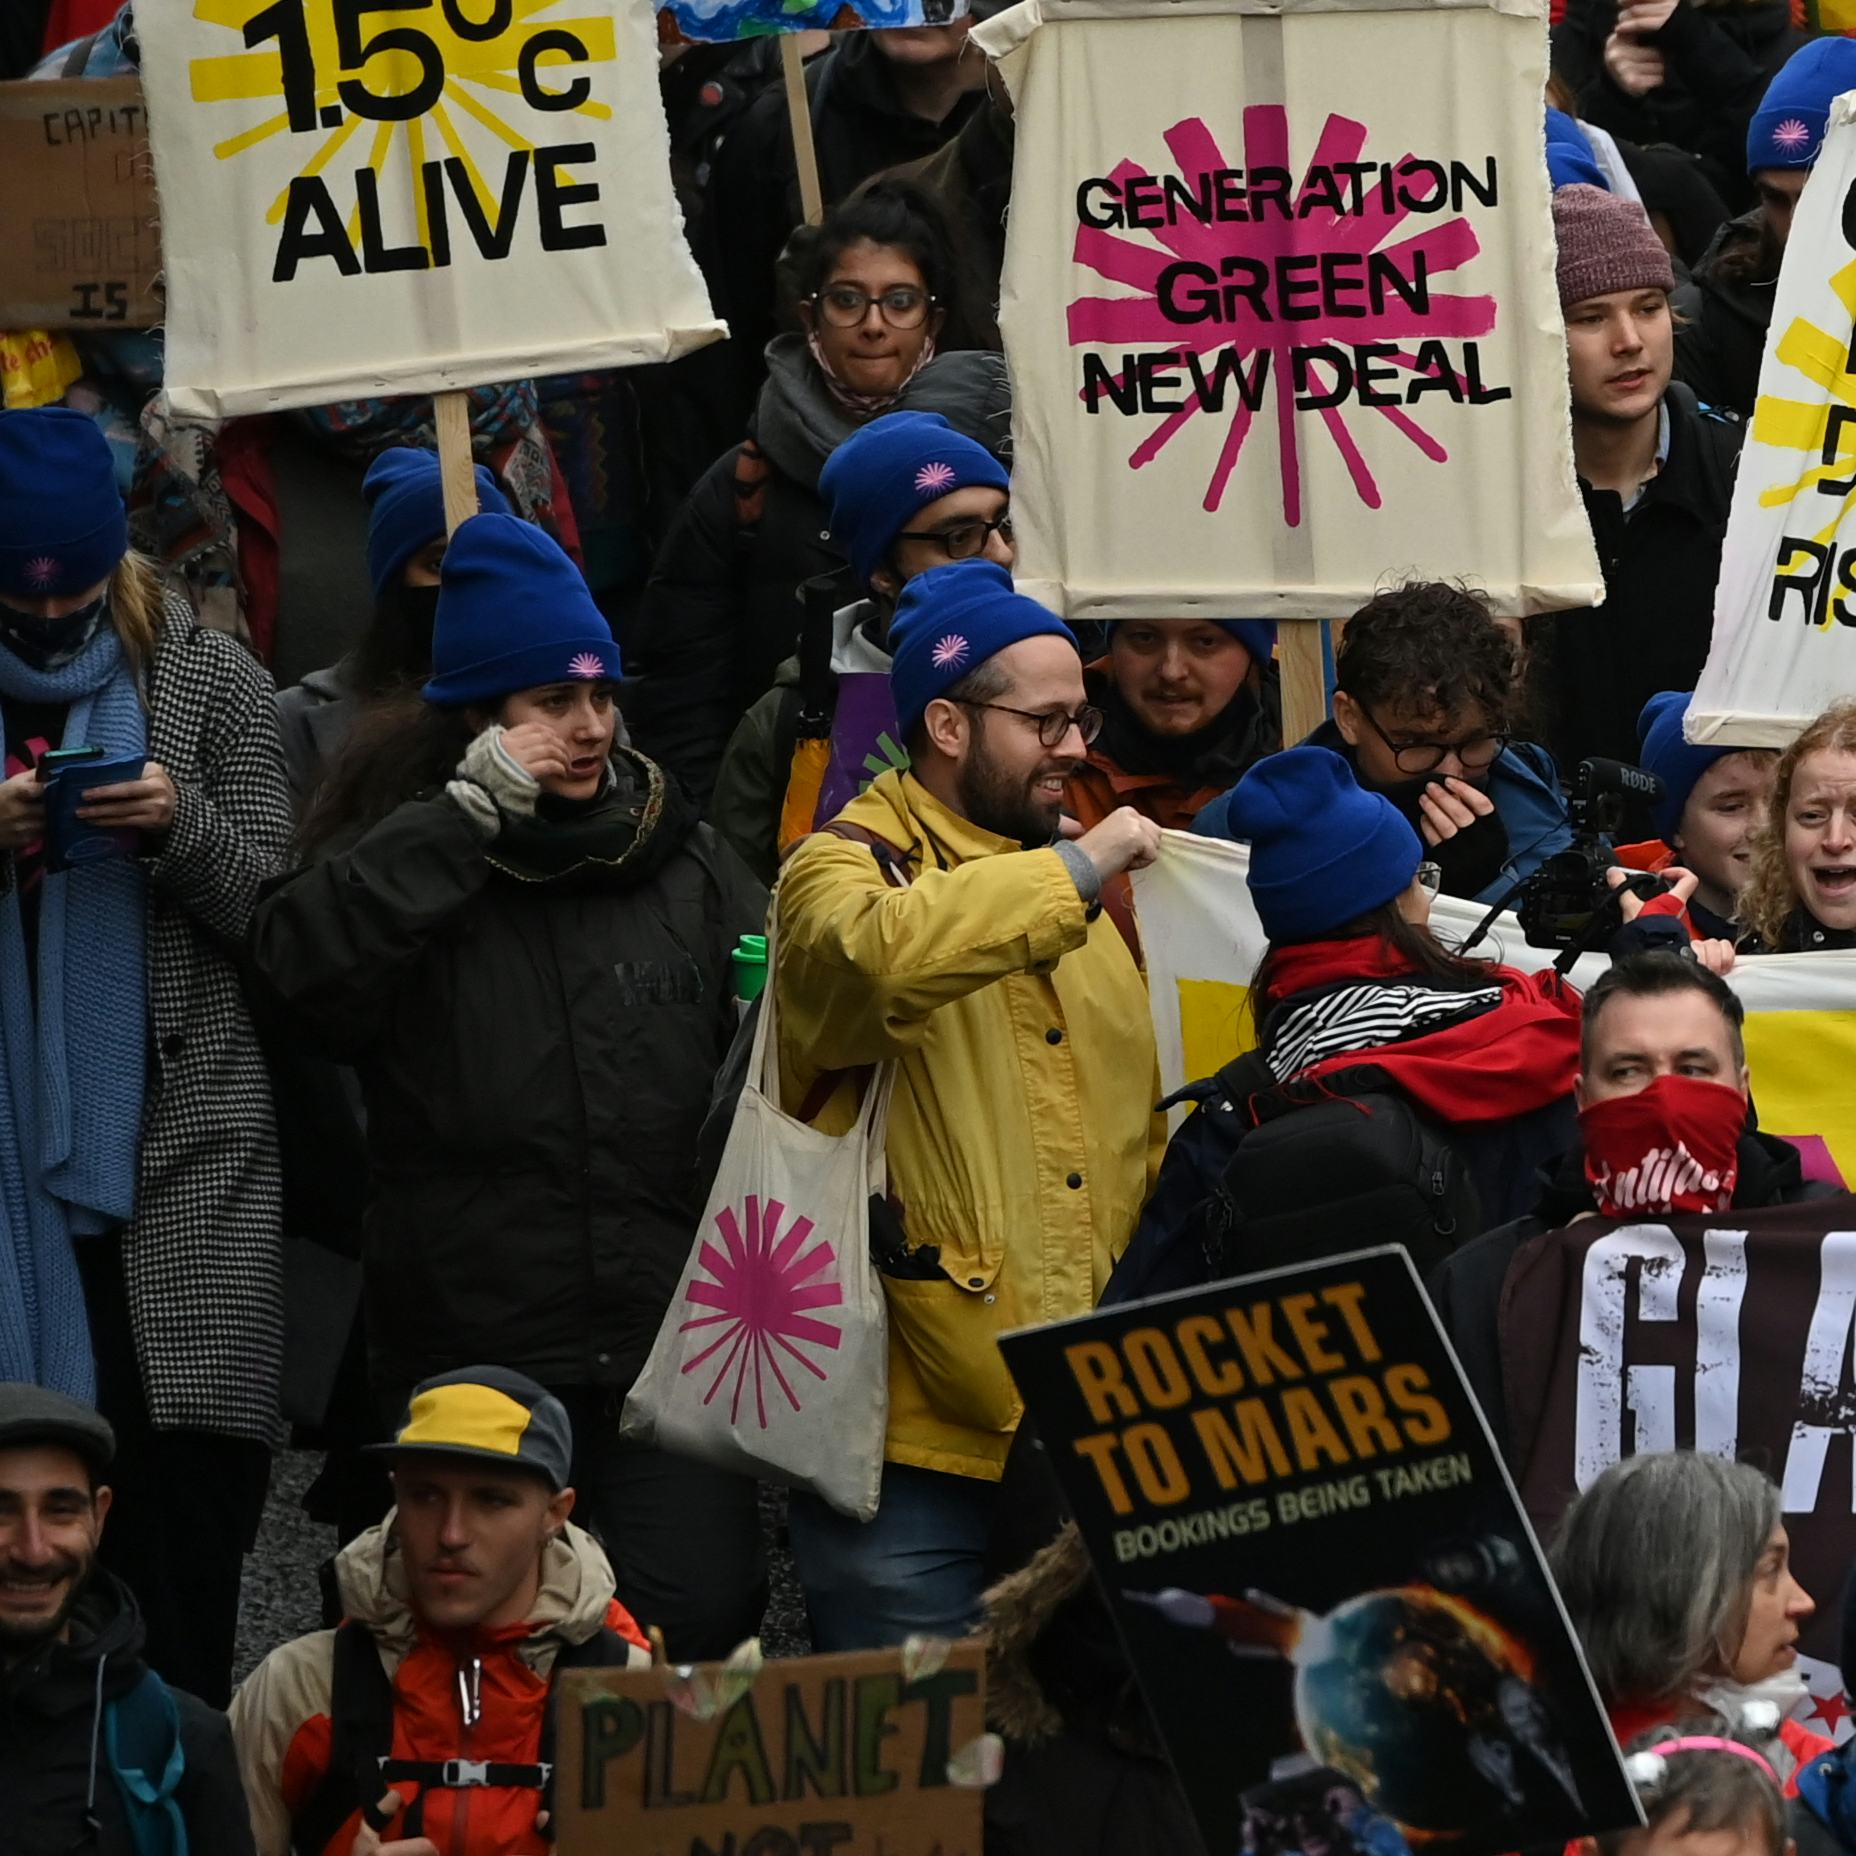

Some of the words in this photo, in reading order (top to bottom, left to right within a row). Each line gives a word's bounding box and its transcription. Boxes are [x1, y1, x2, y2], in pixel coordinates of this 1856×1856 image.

[272, 142, 607, 282] ALIVE
[1075, 154, 1498, 231] GENERATION
[1155, 248, 1430, 327] GREEN
[1081, 347, 1272, 417] NEW
[1294, 341, 1512, 411] DEAL
[1620, 766, 1657, 795] RØDE
[1062, 1283, 1383, 1427] ROCKET
[1072, 1403, 1192, 1515] TO
[1188, 1361, 1454, 1493] MARS
[1113, 1496, 1272, 1564] BOOKINGS
[1275, 1473, 1374, 1523] BEING
[1371, 1452, 1475, 1503] TAKEN
[580, 1669, 979, 1810] PLANET
